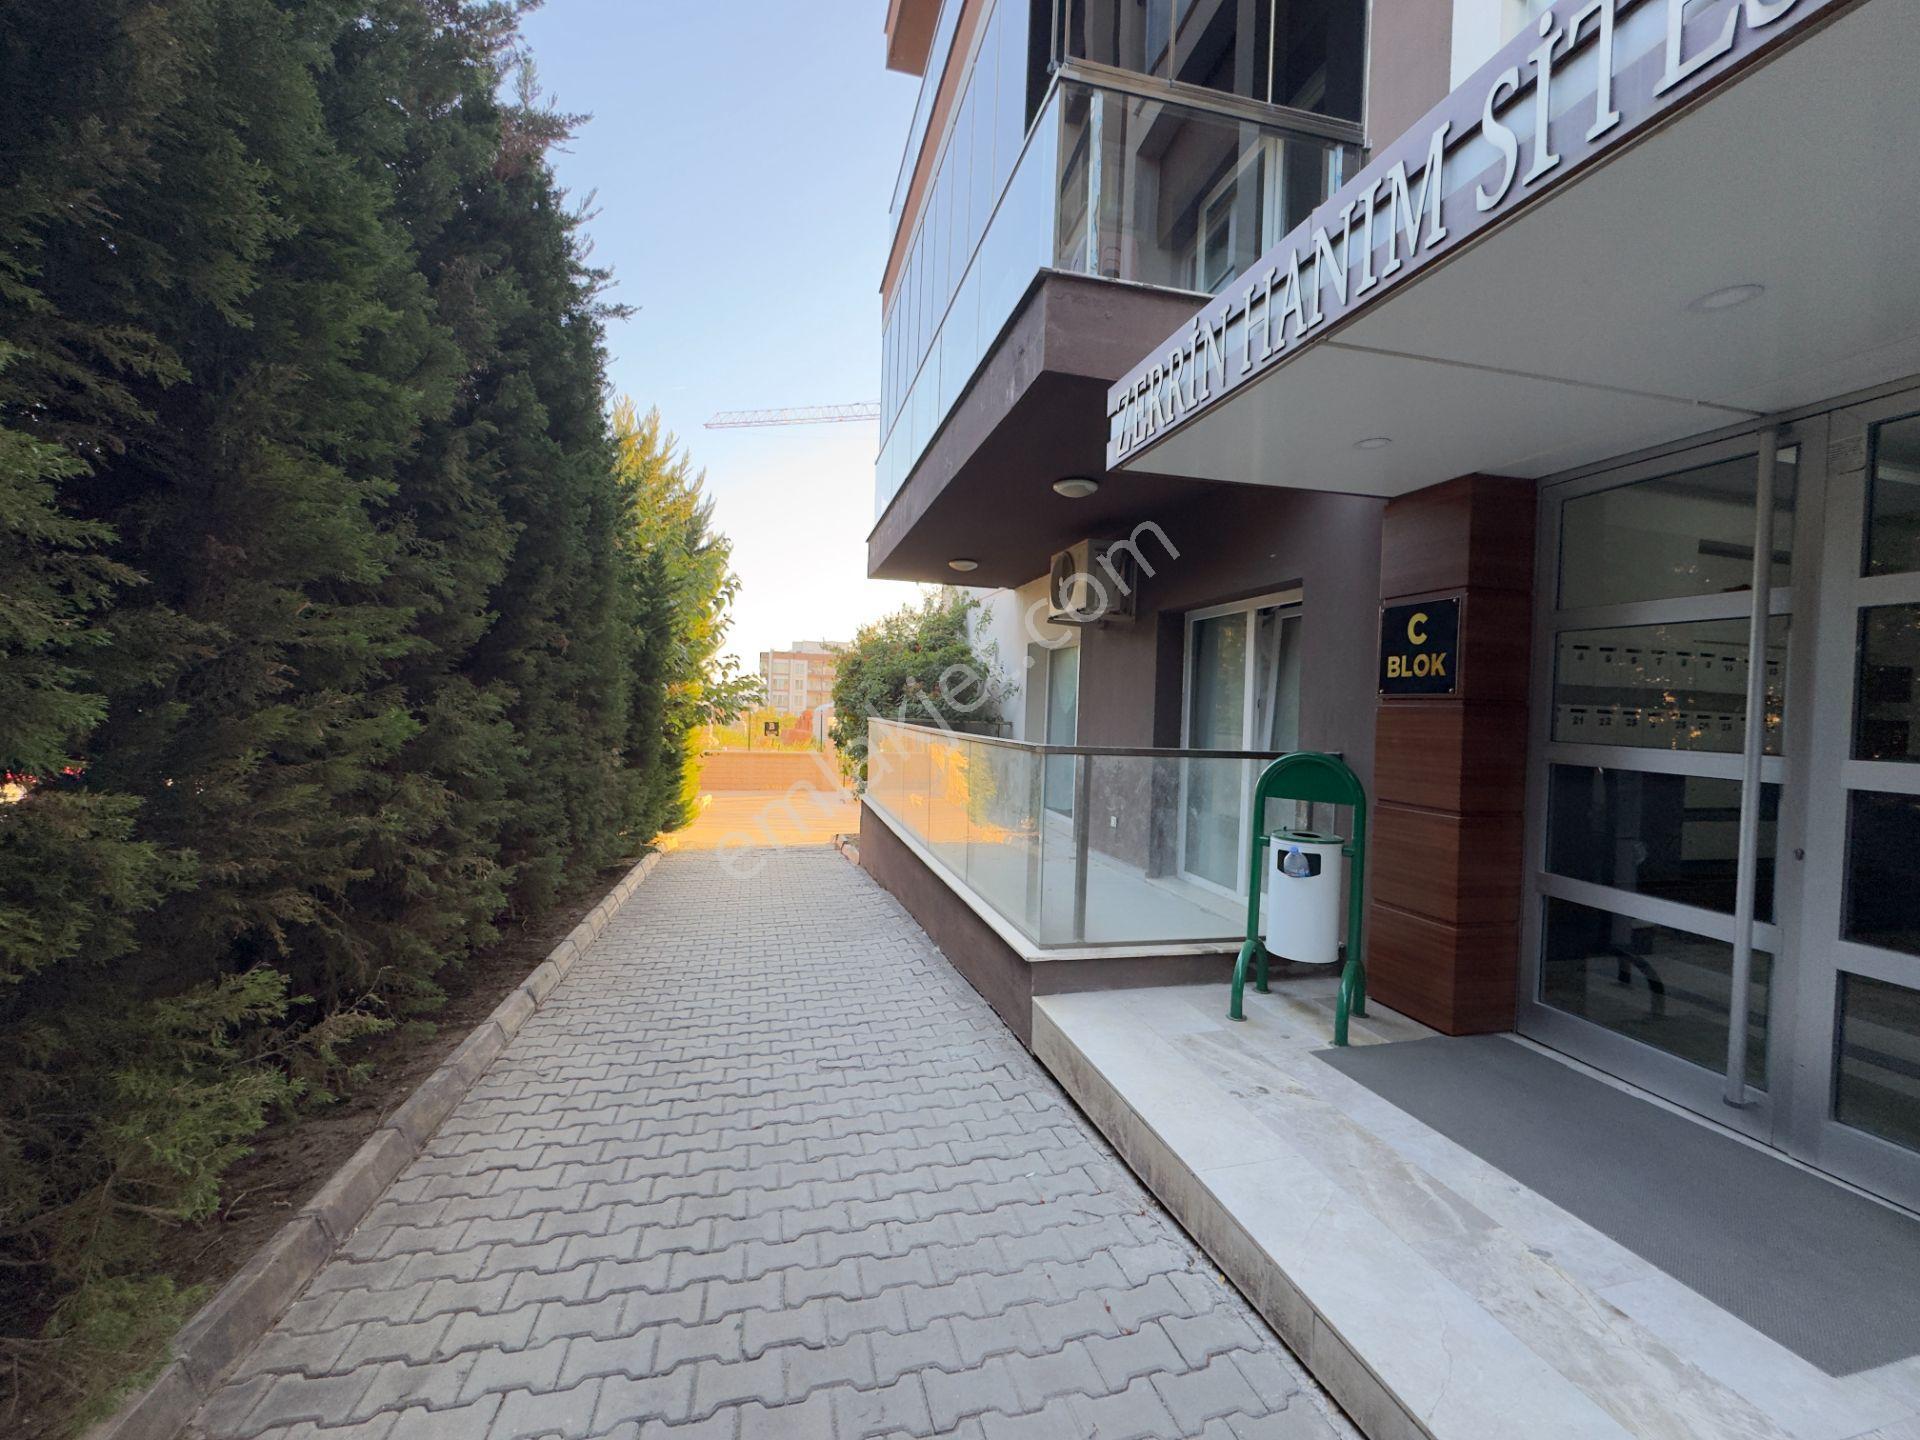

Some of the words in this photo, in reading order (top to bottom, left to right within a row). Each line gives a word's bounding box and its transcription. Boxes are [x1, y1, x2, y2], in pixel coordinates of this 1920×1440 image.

[1116, 303, 1232, 458] ZERRİN
[1240, 120, 1451, 375] HANIM
[1476, 0, 1799, 213] SİTE
[1407, 612, 1429, 646] C
[1386, 652, 1448, 679] BLOK
